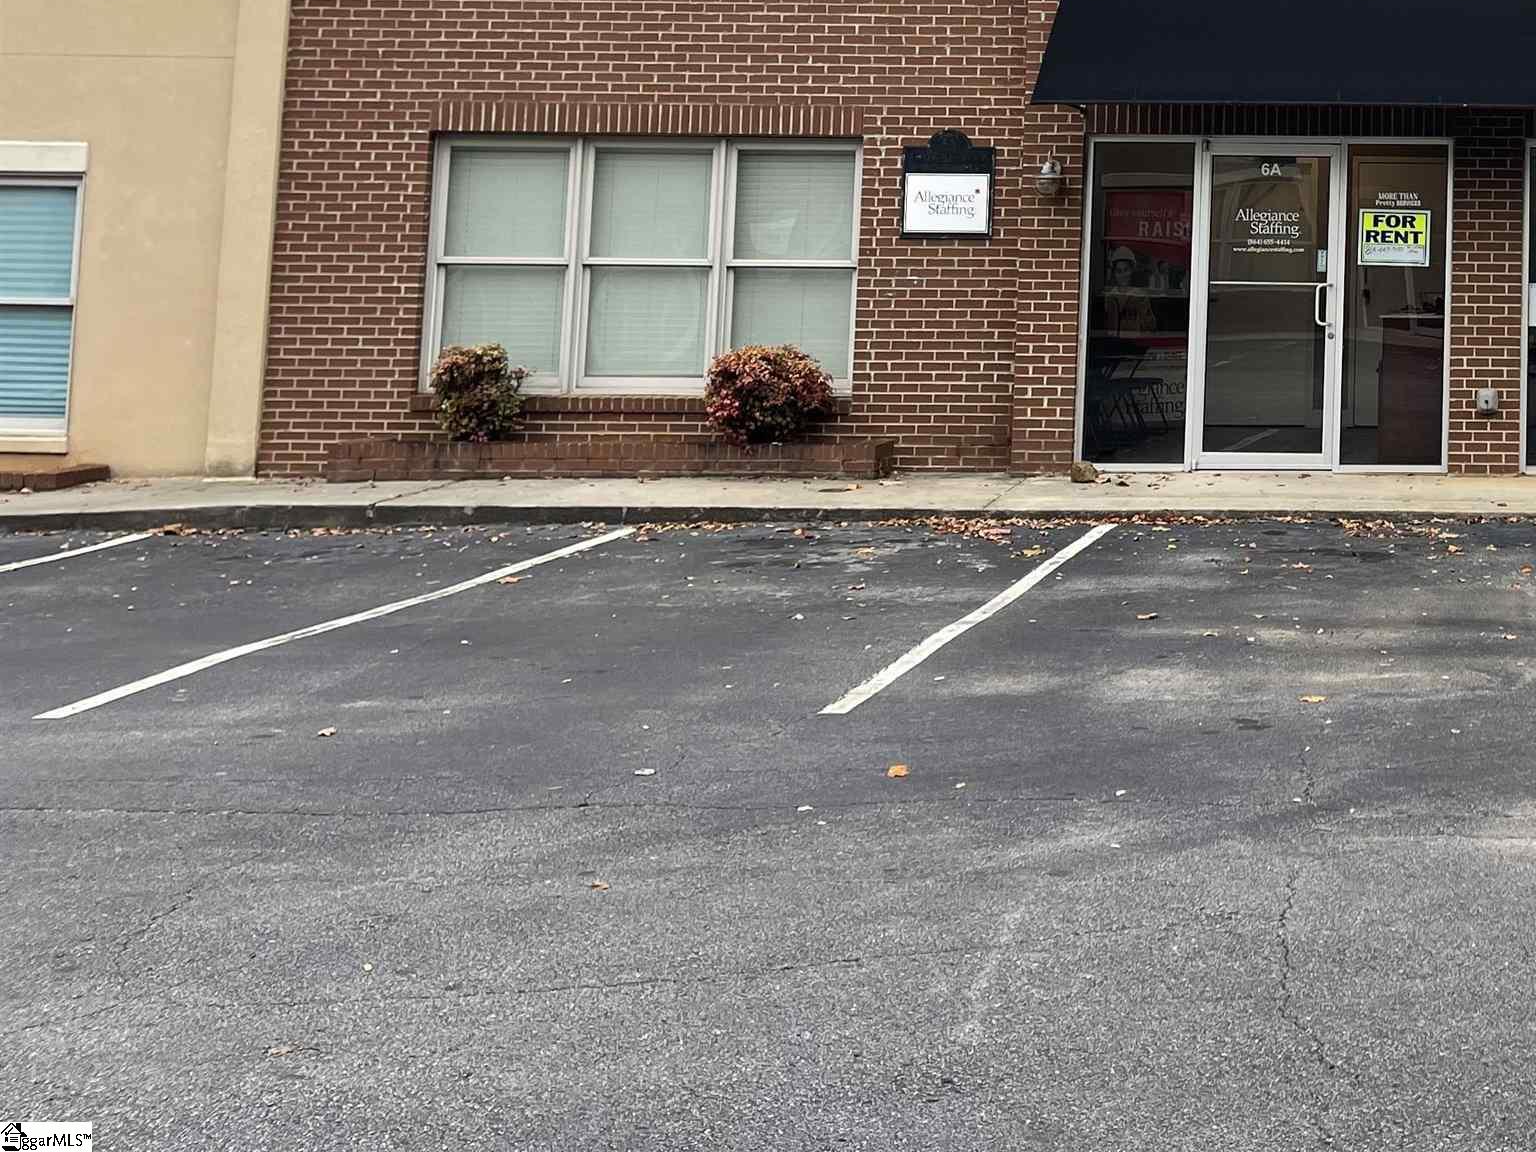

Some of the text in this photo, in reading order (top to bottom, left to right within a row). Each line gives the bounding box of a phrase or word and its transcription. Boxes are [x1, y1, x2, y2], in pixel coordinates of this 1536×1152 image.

[1261, 162, 1282, 176] 6A
[913, 190, 975, 204] Allegiance
[927, 203, 976, 219] Staffing
[1235, 208, 1300, 225] Allegiance
[1373, 214, 1417, 229] FOR
[1365, 230, 1424, 244] RENT
